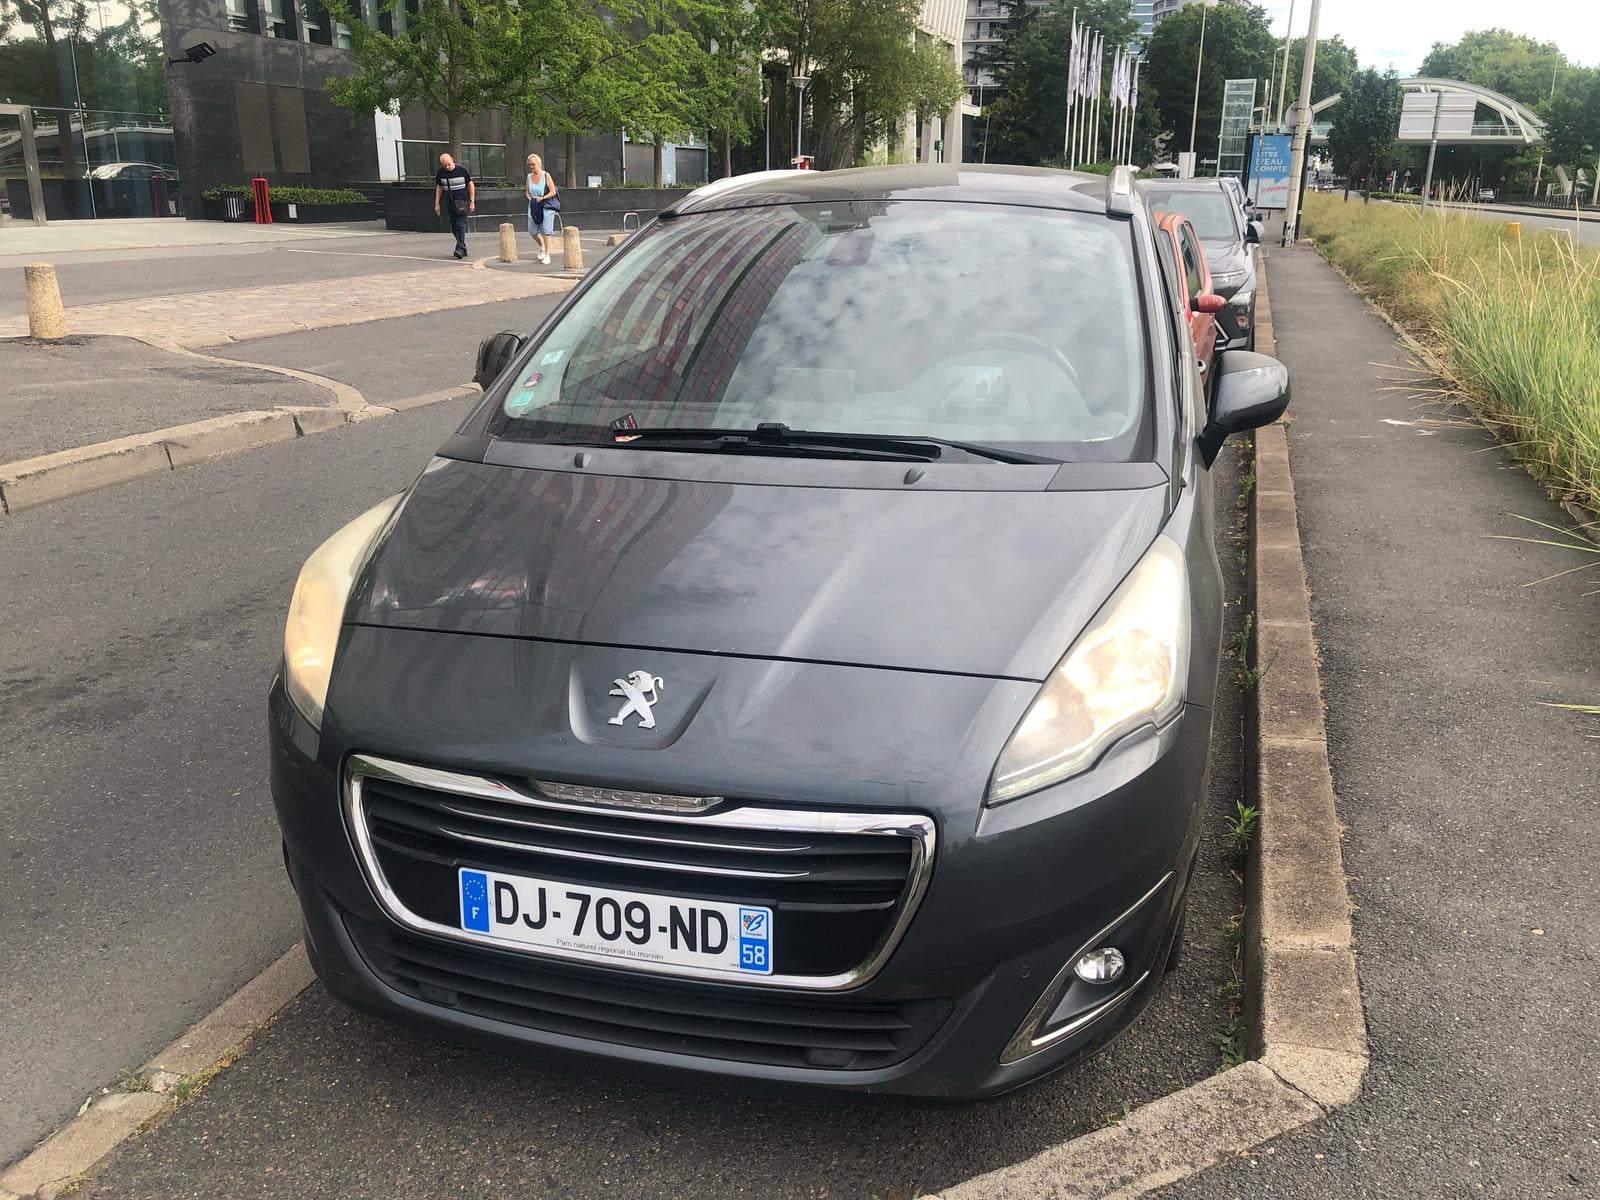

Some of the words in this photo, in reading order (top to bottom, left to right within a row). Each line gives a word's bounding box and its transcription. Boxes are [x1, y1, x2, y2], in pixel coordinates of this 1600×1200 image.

[556, 784, 683, 807] PEUGEOT
[471, 906, 480, 920] F
[493, 880, 728, 955] DJ-709-ND
[556, 938, 572, 947] Parc
[573, 942, 597, 950] naturel
[627, 949, 636, 957] du
[637, 951, 664, 960] morvan
[742, 943, 766, 966] 58
